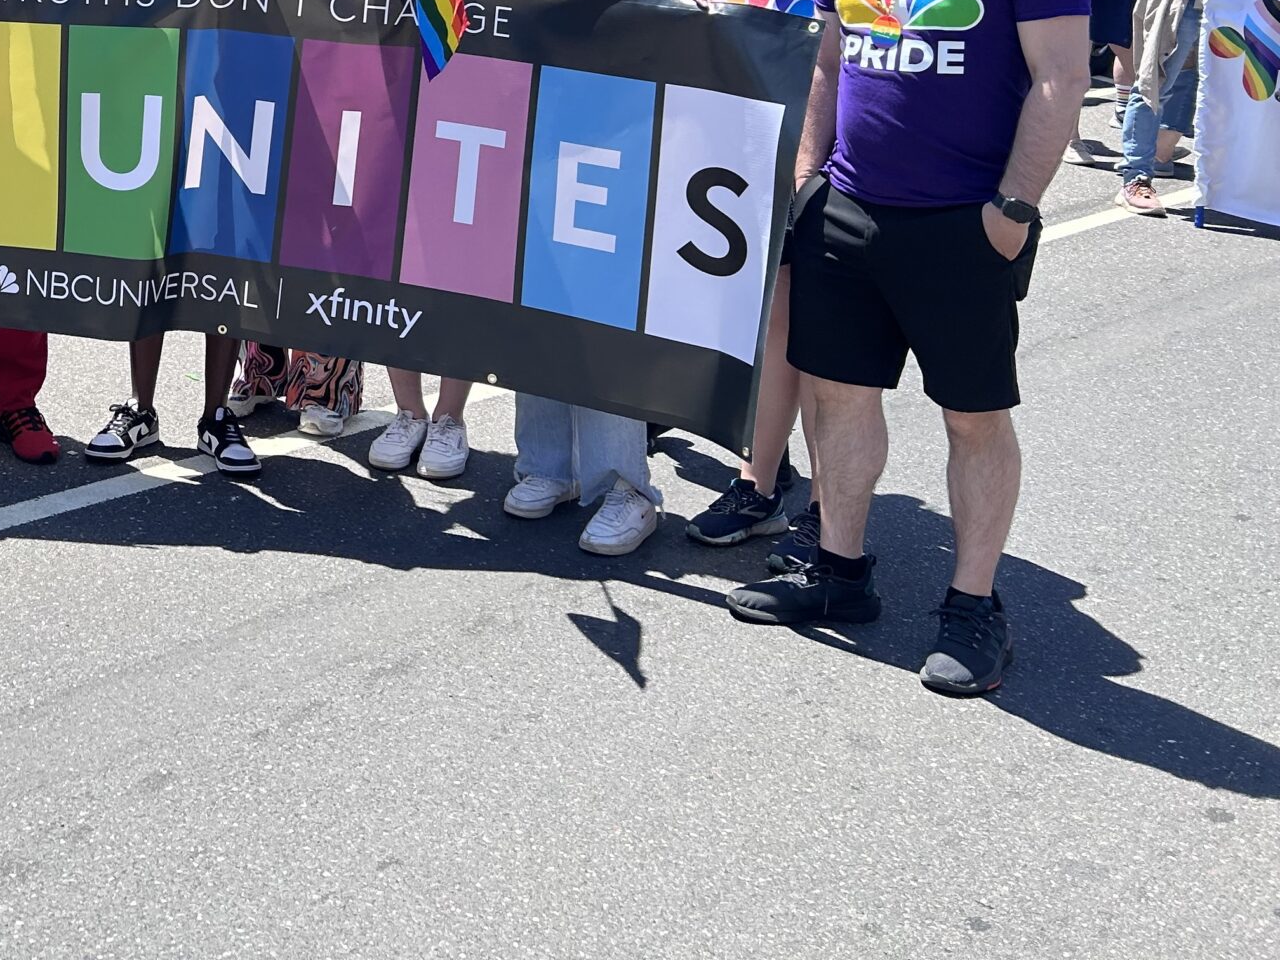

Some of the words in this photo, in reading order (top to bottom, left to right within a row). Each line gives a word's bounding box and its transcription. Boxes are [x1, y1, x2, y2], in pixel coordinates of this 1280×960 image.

[80, 92, 749, 277] UNITES
[26, 268, 259, 309] NBCUNIVERSAL
[305, 287, 423, 339] xfinity
